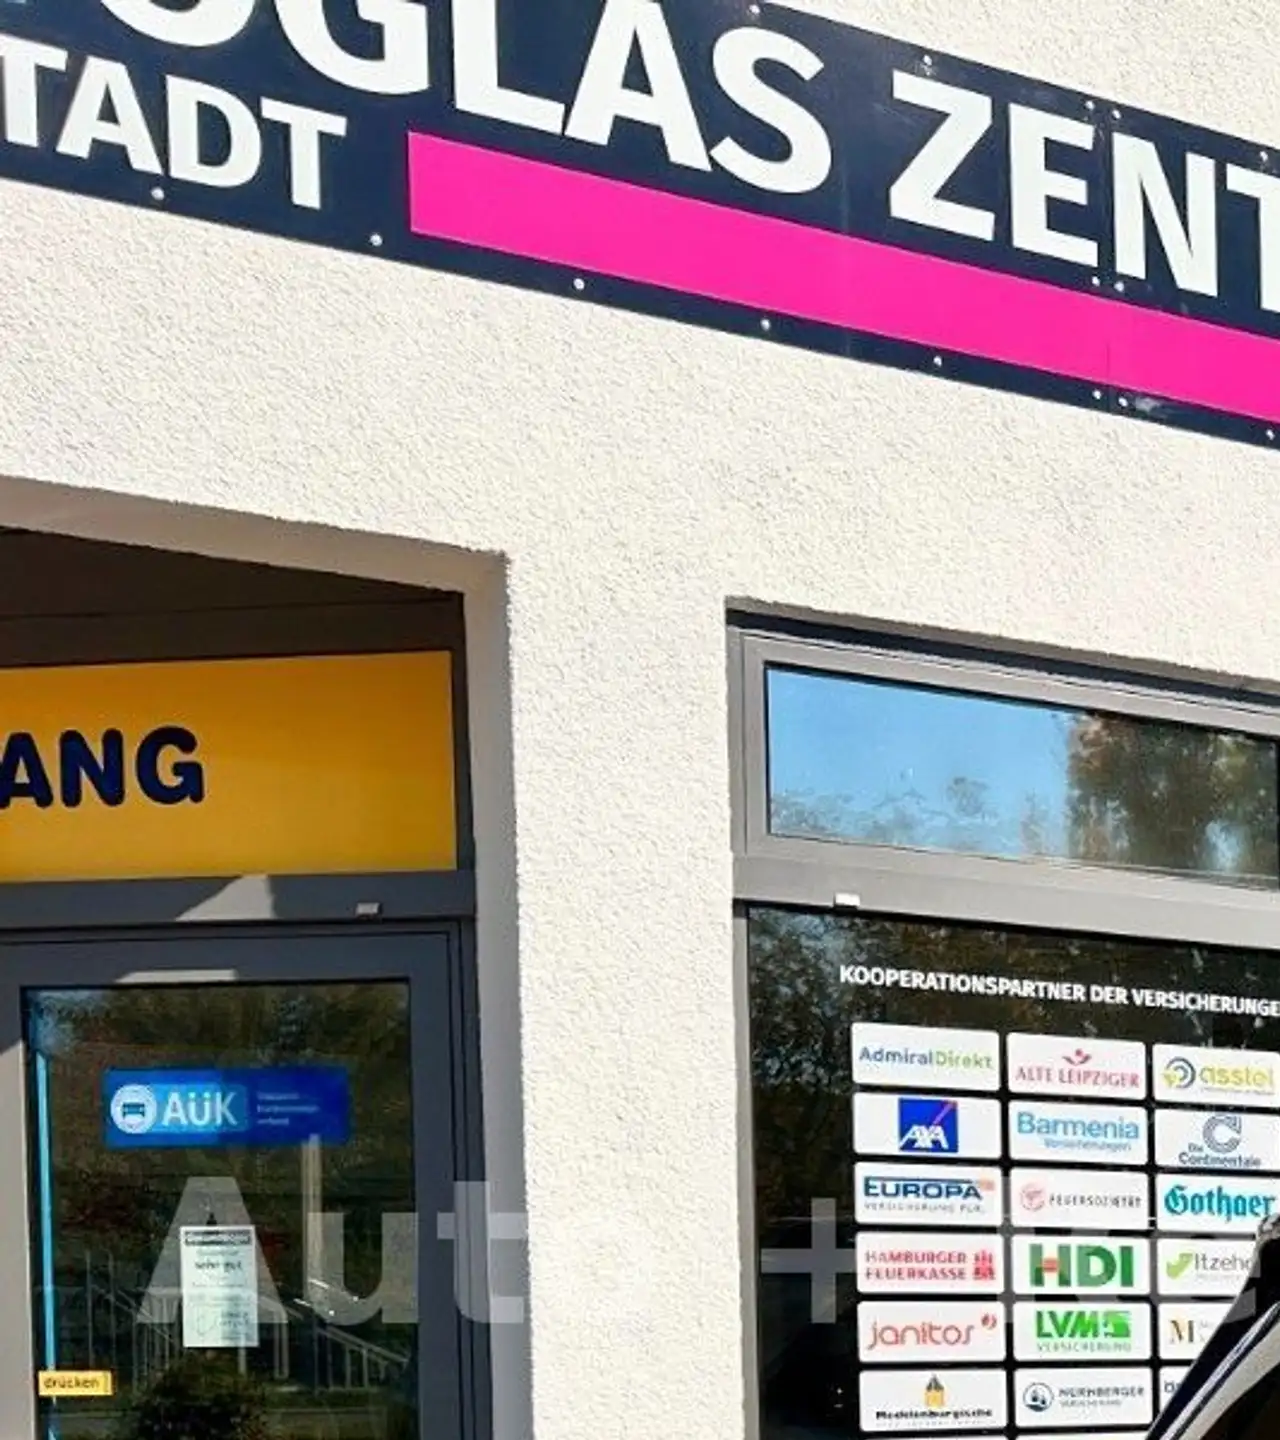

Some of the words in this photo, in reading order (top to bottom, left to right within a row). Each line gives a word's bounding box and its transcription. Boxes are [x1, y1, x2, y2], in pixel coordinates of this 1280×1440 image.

[0, 33, 348, 210] TADT
[0, 724, 206, 809] ANG
[839, 964, 1087, 1001] KOOPERATIONSPARTNER
[1089, 983, 1130, 1004] DER
[859, 1046, 994, 1070] AdmiralDirekt
[1014, 1066, 1053, 1083] ALTE
[1058, 1067, 1141, 1089] LEIPZIGER
[899, 1123, 949, 1150] AXA
[1017, 1111, 1140, 1140] Barmenia
[863, 1176, 983, 1200] EUROPA
[1164, 1184, 1277, 1222] Gothaer
[864, 1250, 968, 1265] HAMBURGER
[1029, 1242, 1135, 1288] HDI
[864, 1267, 967, 1281] FEUERKASSE
[868, 1320, 975, 1351] janitos
[1035, 1310, 1099, 1338] LVM
